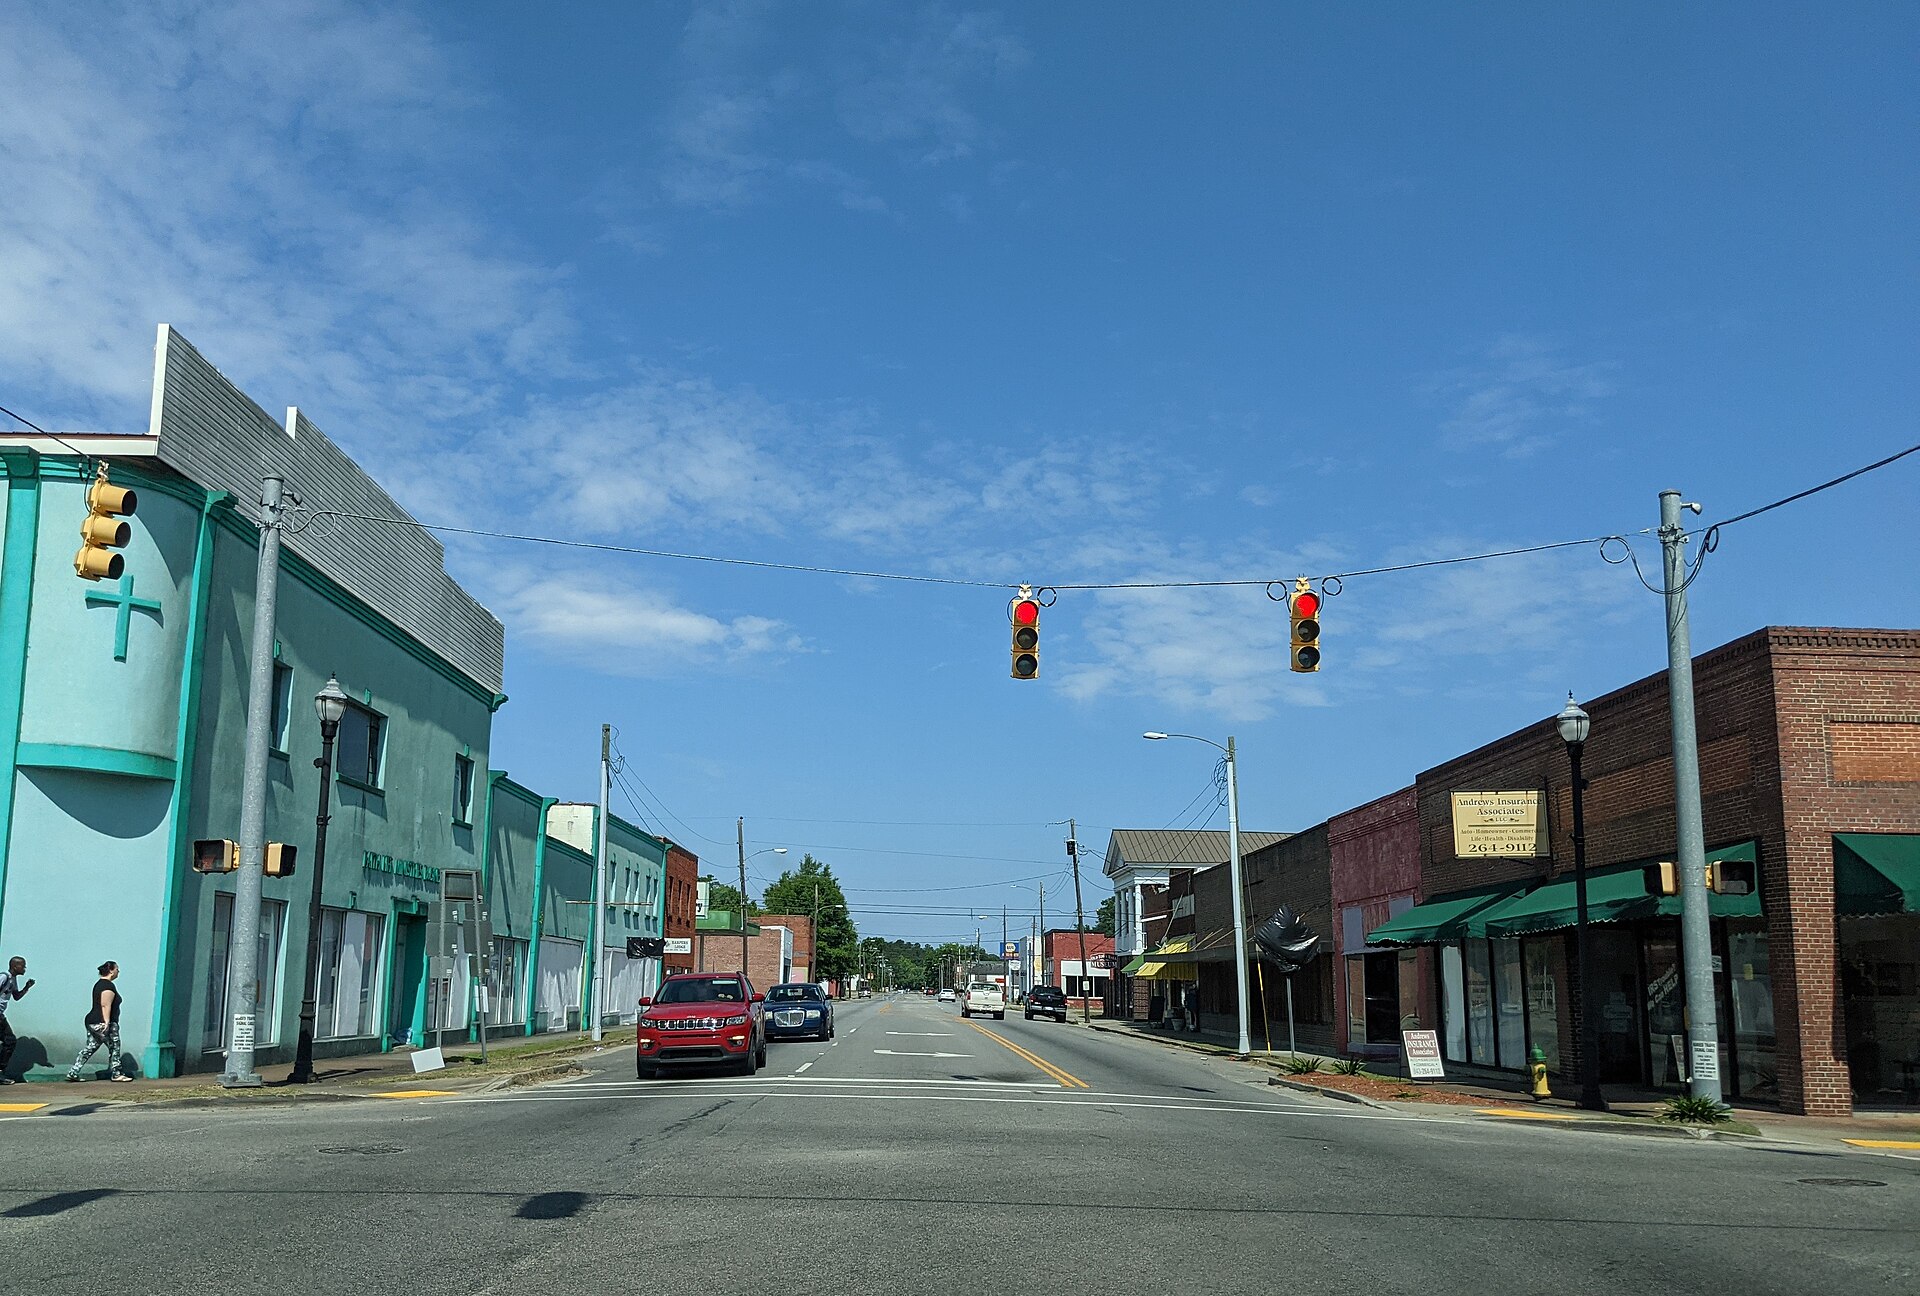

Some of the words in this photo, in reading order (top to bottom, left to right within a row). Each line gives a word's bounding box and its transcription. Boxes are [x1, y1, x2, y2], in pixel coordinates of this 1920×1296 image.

[1457, 798, 1495, 806] Andrews
[1468, 843, 1538, 853] 264-9112
[1407, 1039, 1436, 1048] INSURANCE
